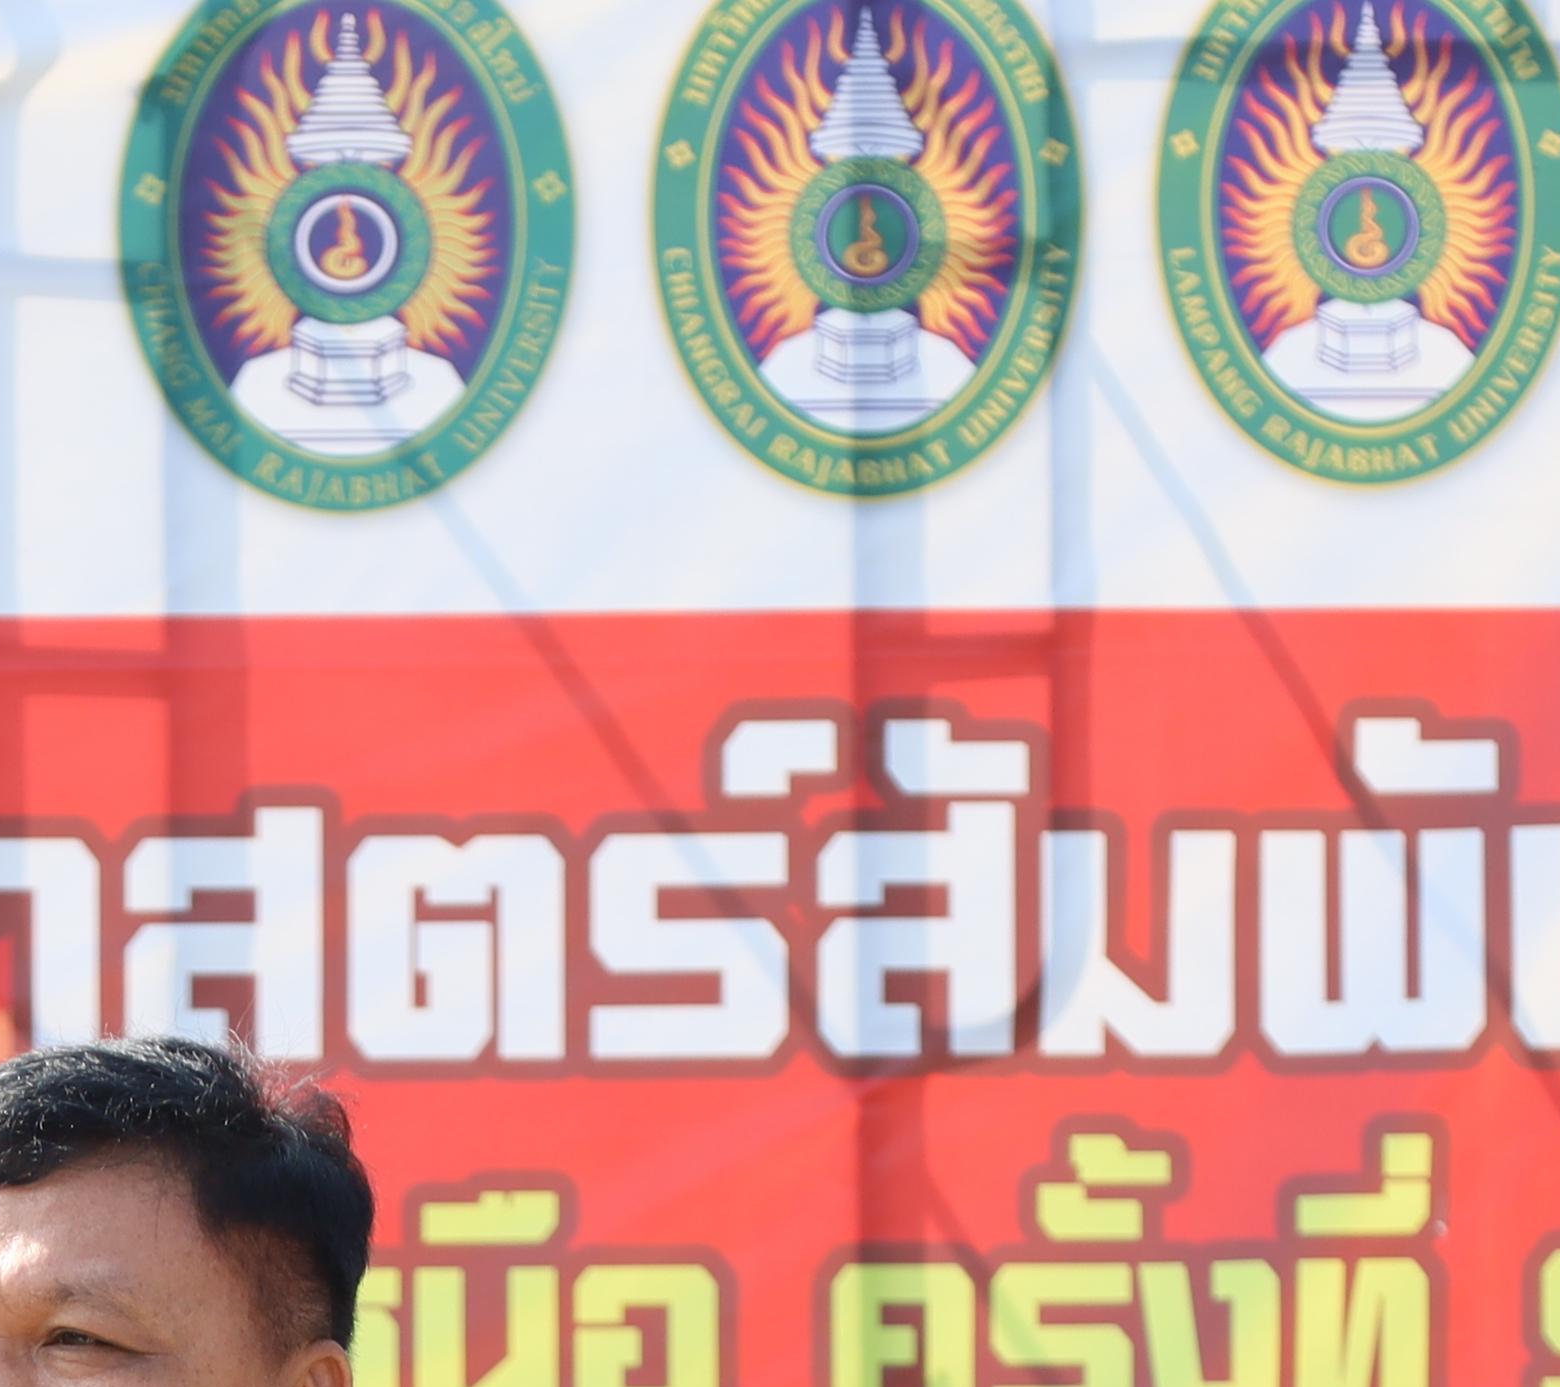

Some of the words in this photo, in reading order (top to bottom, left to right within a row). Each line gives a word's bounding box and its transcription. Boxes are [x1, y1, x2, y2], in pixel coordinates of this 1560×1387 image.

[136, 259, 202, 389] CHIANG
[189, 392, 244, 458] MAI
[252, 449, 450, 505] RAJABHAT
[452, 256, 567, 453] UNIVERSITY
[662, 245, 770, 440] CHIANGRAI
[767, 435, 952, 488] RAJABHAT
[957, 238, 1074, 449] UNIVERSITY
[1167, 246, 1266, 417] LAMPANG
[1261, 413, 1441, 474] RAJABHAT
